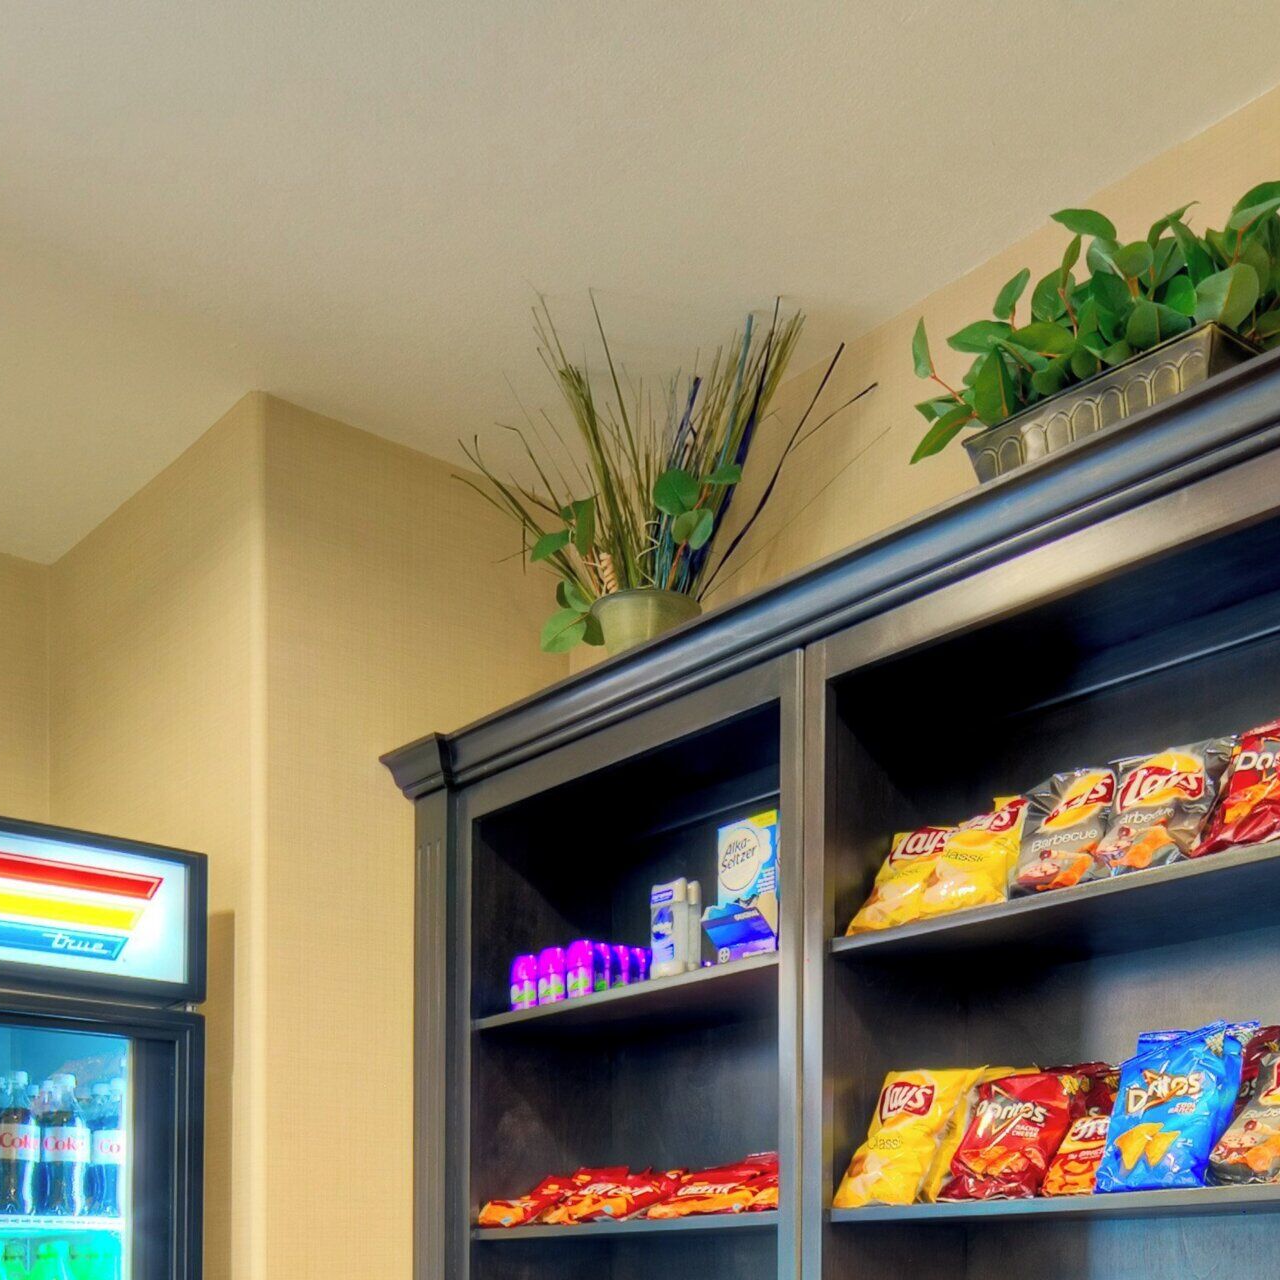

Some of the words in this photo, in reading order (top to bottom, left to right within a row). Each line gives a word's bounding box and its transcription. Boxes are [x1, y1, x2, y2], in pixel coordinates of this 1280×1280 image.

[1119, 806, 1174, 826] arbecue
[724, 837, 752, 857] Alka-
[1031, 828, 1097, 852] Barbecue
[721, 845, 758, 873] Seltzer
[880, 1084, 933, 1120] Lay's
[976, 1100, 1048, 1132] Doritos
